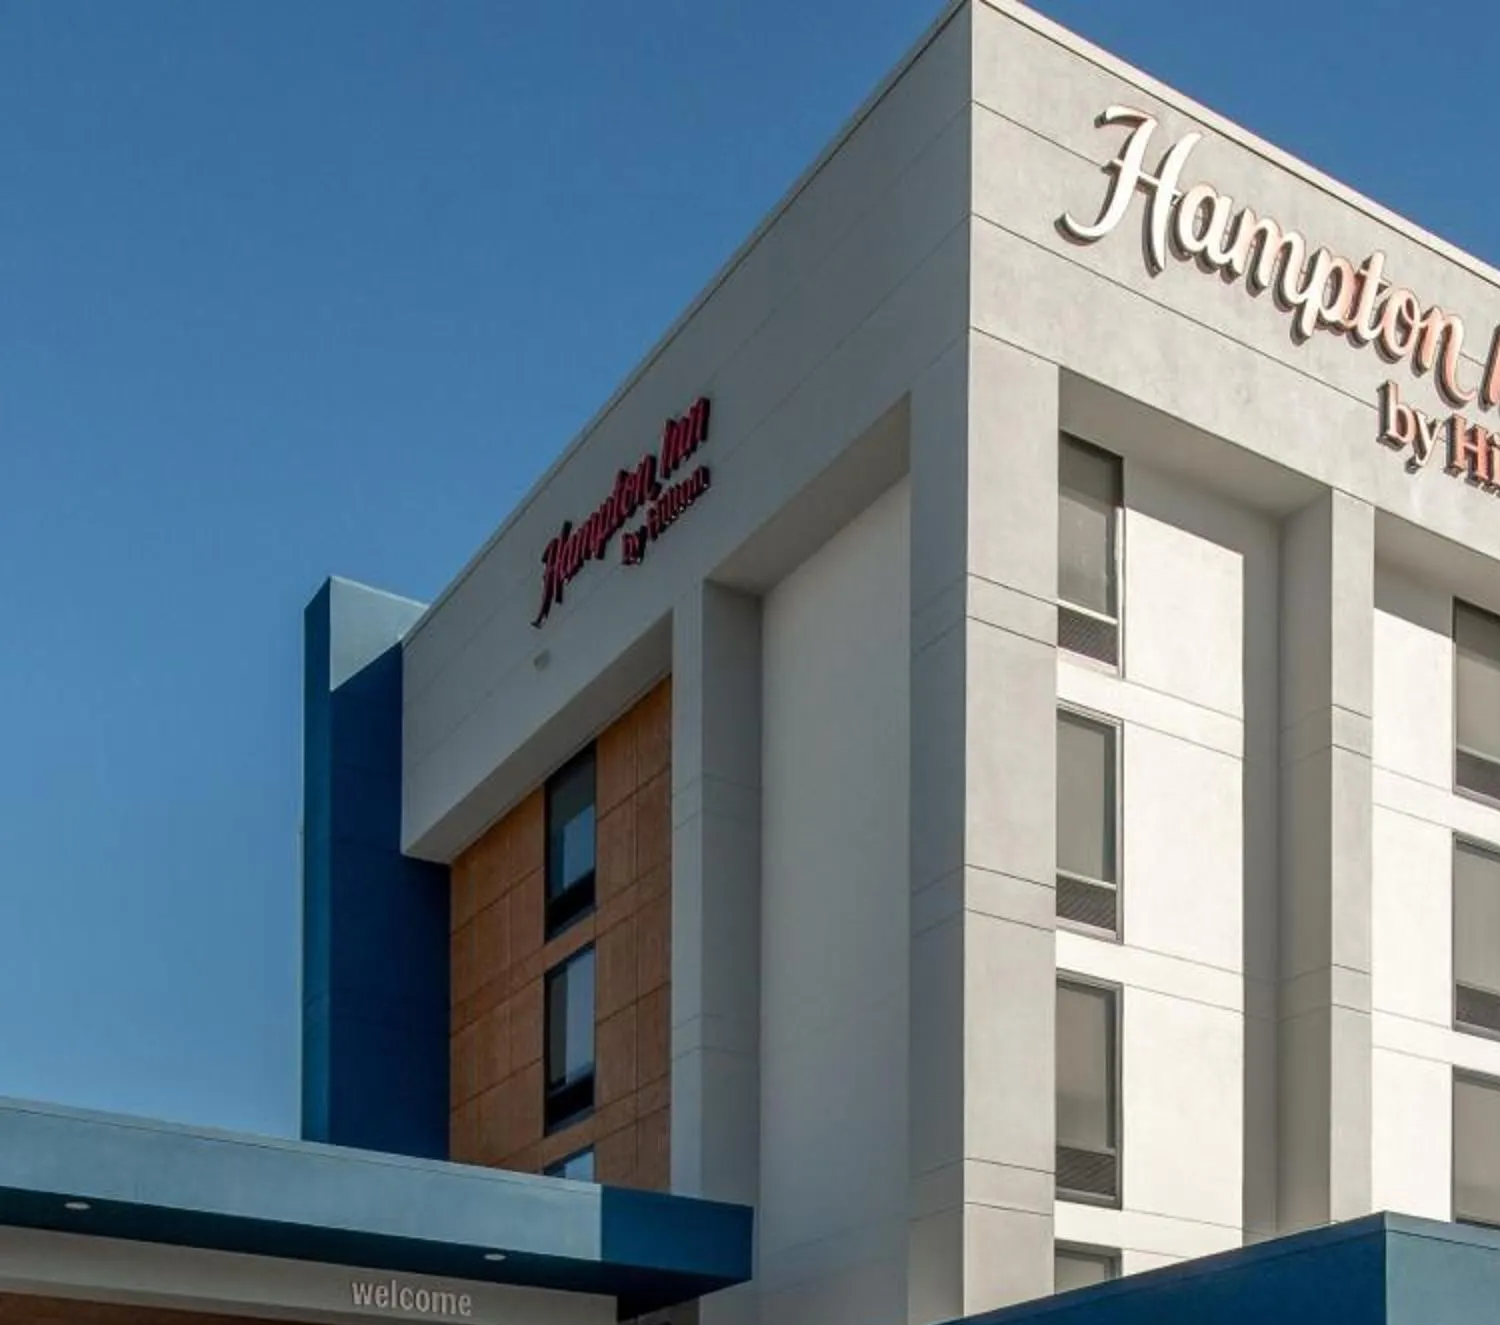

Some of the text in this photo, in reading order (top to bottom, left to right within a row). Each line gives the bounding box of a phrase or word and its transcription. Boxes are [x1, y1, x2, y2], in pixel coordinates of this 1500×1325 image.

[1054, 104, 1476, 408] Hampton
[1376, 380, 1444, 473] by
[352, 1280, 472, 1317] welcome
